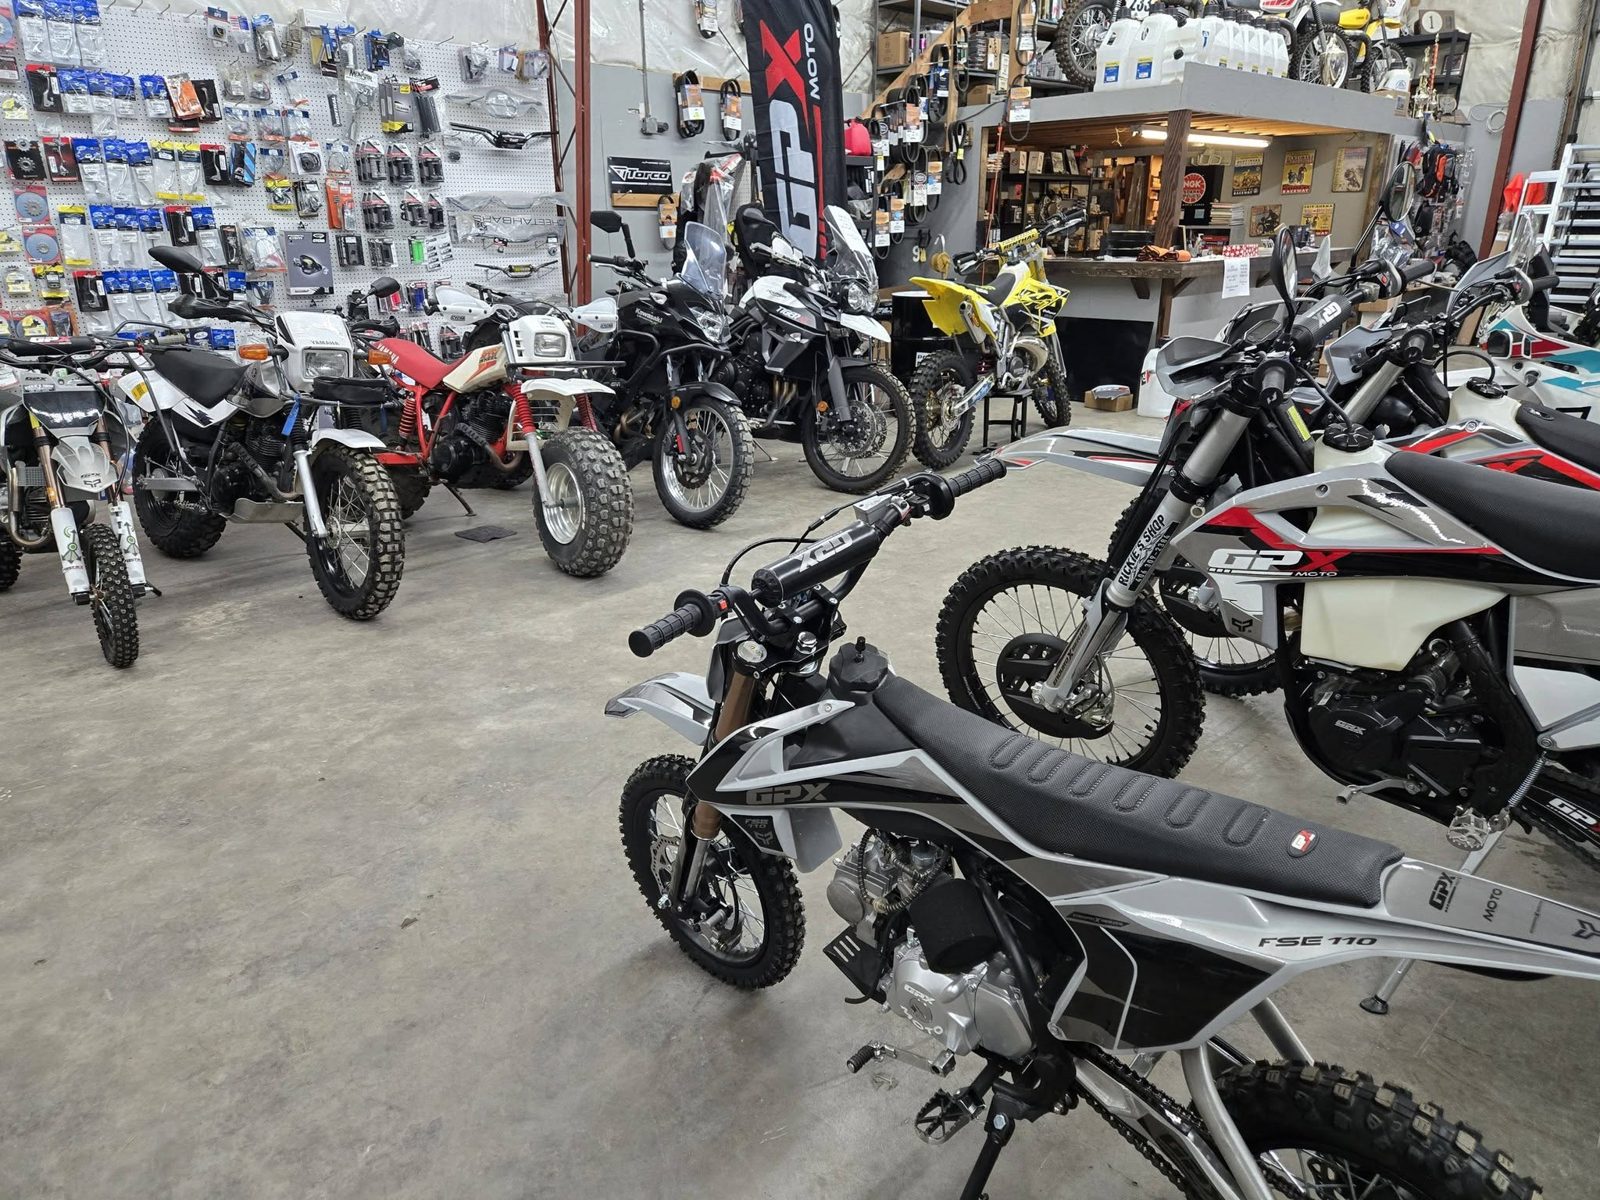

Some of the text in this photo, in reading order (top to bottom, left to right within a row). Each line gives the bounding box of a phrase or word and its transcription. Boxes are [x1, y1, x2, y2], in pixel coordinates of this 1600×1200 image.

[804, 23, 821, 100] MOTO
[759, 19, 818, 260] GPX
[626, 167, 672, 181] Torco
[1183, 180, 1201, 188] NGK
[473, 214, 564, 226] CHEETAHBARS
[1003, 233, 1036, 249] RENTHAL
[634, 307, 664, 323] Kawasaki
[800, 530, 853, 573] GPX
[1118, 514, 1167, 587] RICKIE'S SHOP
[1208, 548, 1351, 573] GPX
[745, 782, 832, 805] GPX
[1428, 871, 1456, 911] GPX
[1482, 888, 1503, 923] MOTO
[1258, 936, 1378, 948] FSE 110
[904, 983, 936, 1005] GPX
[900, 1004, 944, 1035] MOTO
